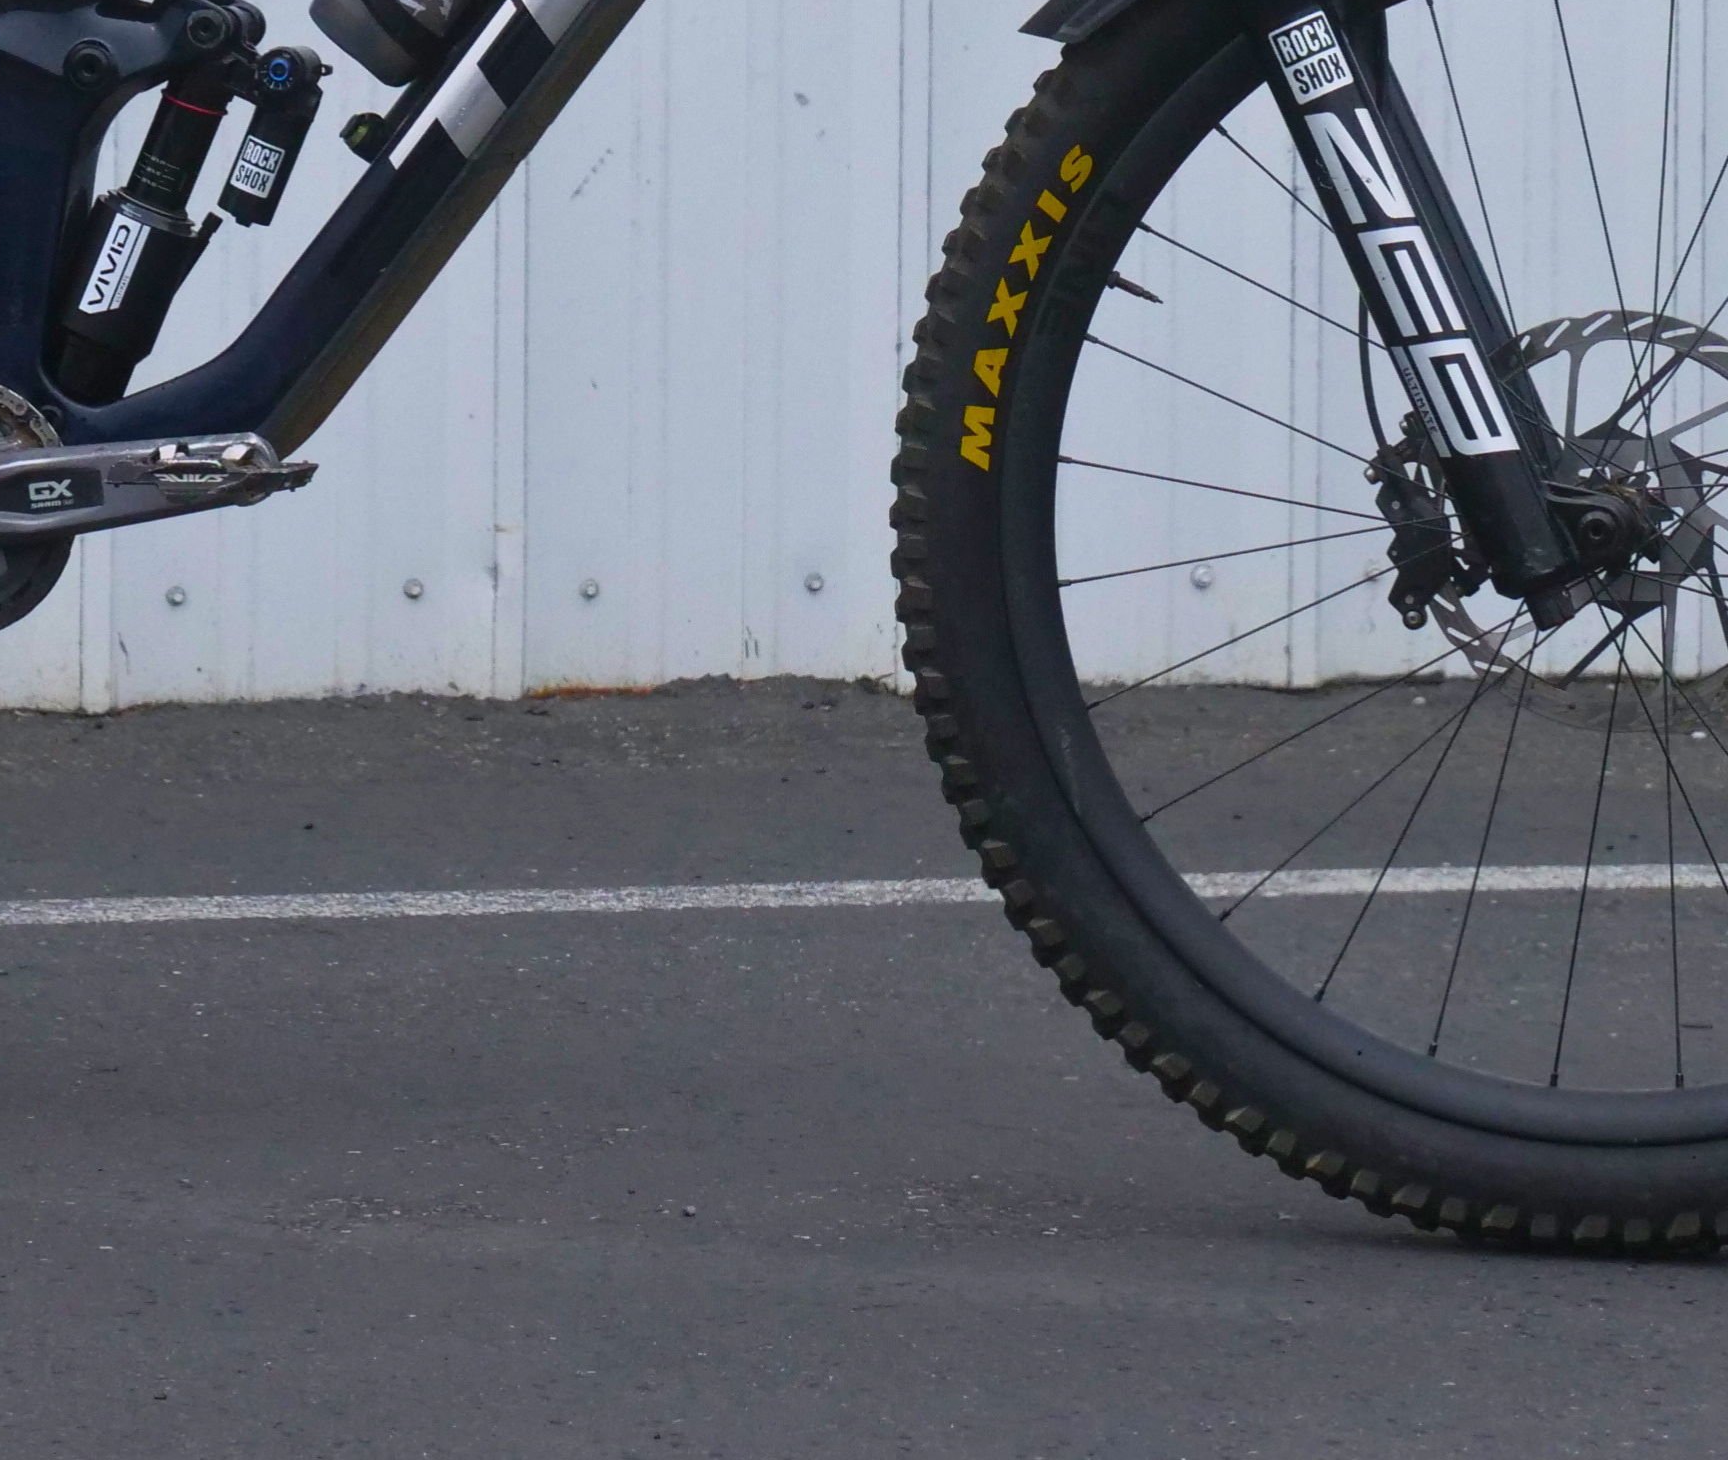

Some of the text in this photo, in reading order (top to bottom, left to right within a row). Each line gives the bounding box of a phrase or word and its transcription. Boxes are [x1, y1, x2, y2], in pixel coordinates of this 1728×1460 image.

[1276, 18, 1333, 64] ROCK
[1292, 52, 1347, 95] SHOX
[242, 140, 281, 171] ROCK
[235, 164, 271, 194] SHOX
[87, 224, 131, 307] VIVID
[1305, 108, 1520, 456] ZEB
[960, 144, 1095, 472] MAXXIS
[1403, 367, 1438, 433] ULTIMATE
[28, 479, 74, 502] GX
